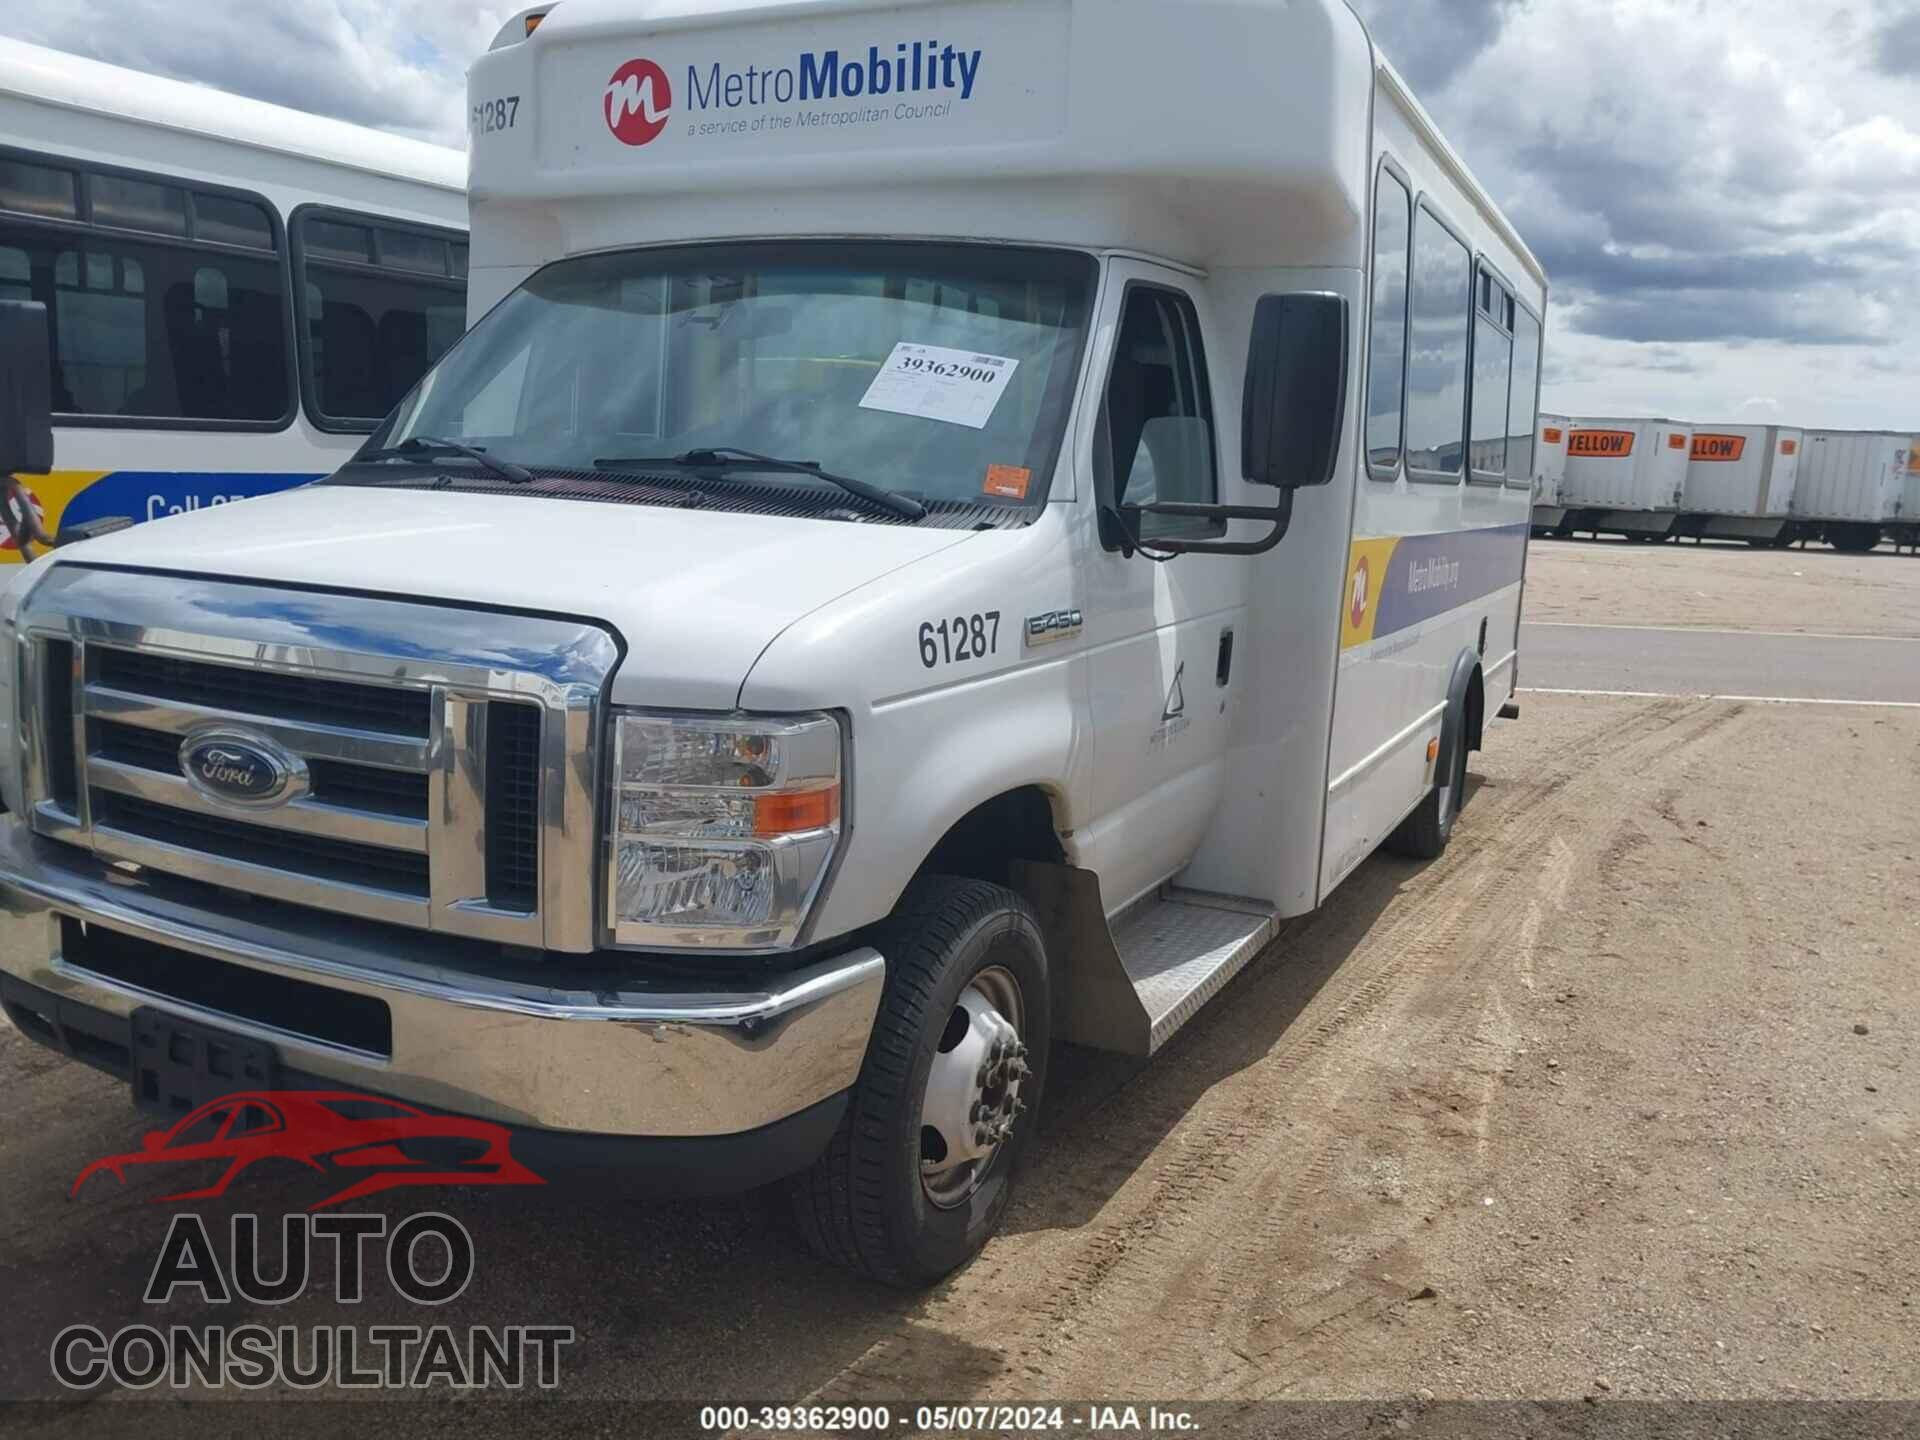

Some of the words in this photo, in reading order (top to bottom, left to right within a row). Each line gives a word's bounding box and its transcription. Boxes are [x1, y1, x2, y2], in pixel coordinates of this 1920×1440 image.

[687, 41, 982, 112] MetroMobility
[687, 124, 696, 136] a
[699, 119, 748, 136] service
[750, 112, 765, 132] of
[770, 112, 792, 129] the
[797, 107, 889, 130] Metropolitan
[894, 100, 951, 120] Council
[897, 357, 996, 384] 39362900
[1567, 434, 1625, 452] YELLOW
[918, 610, 1001, 669] 61287
[202, 750, 256, 786] Ford
